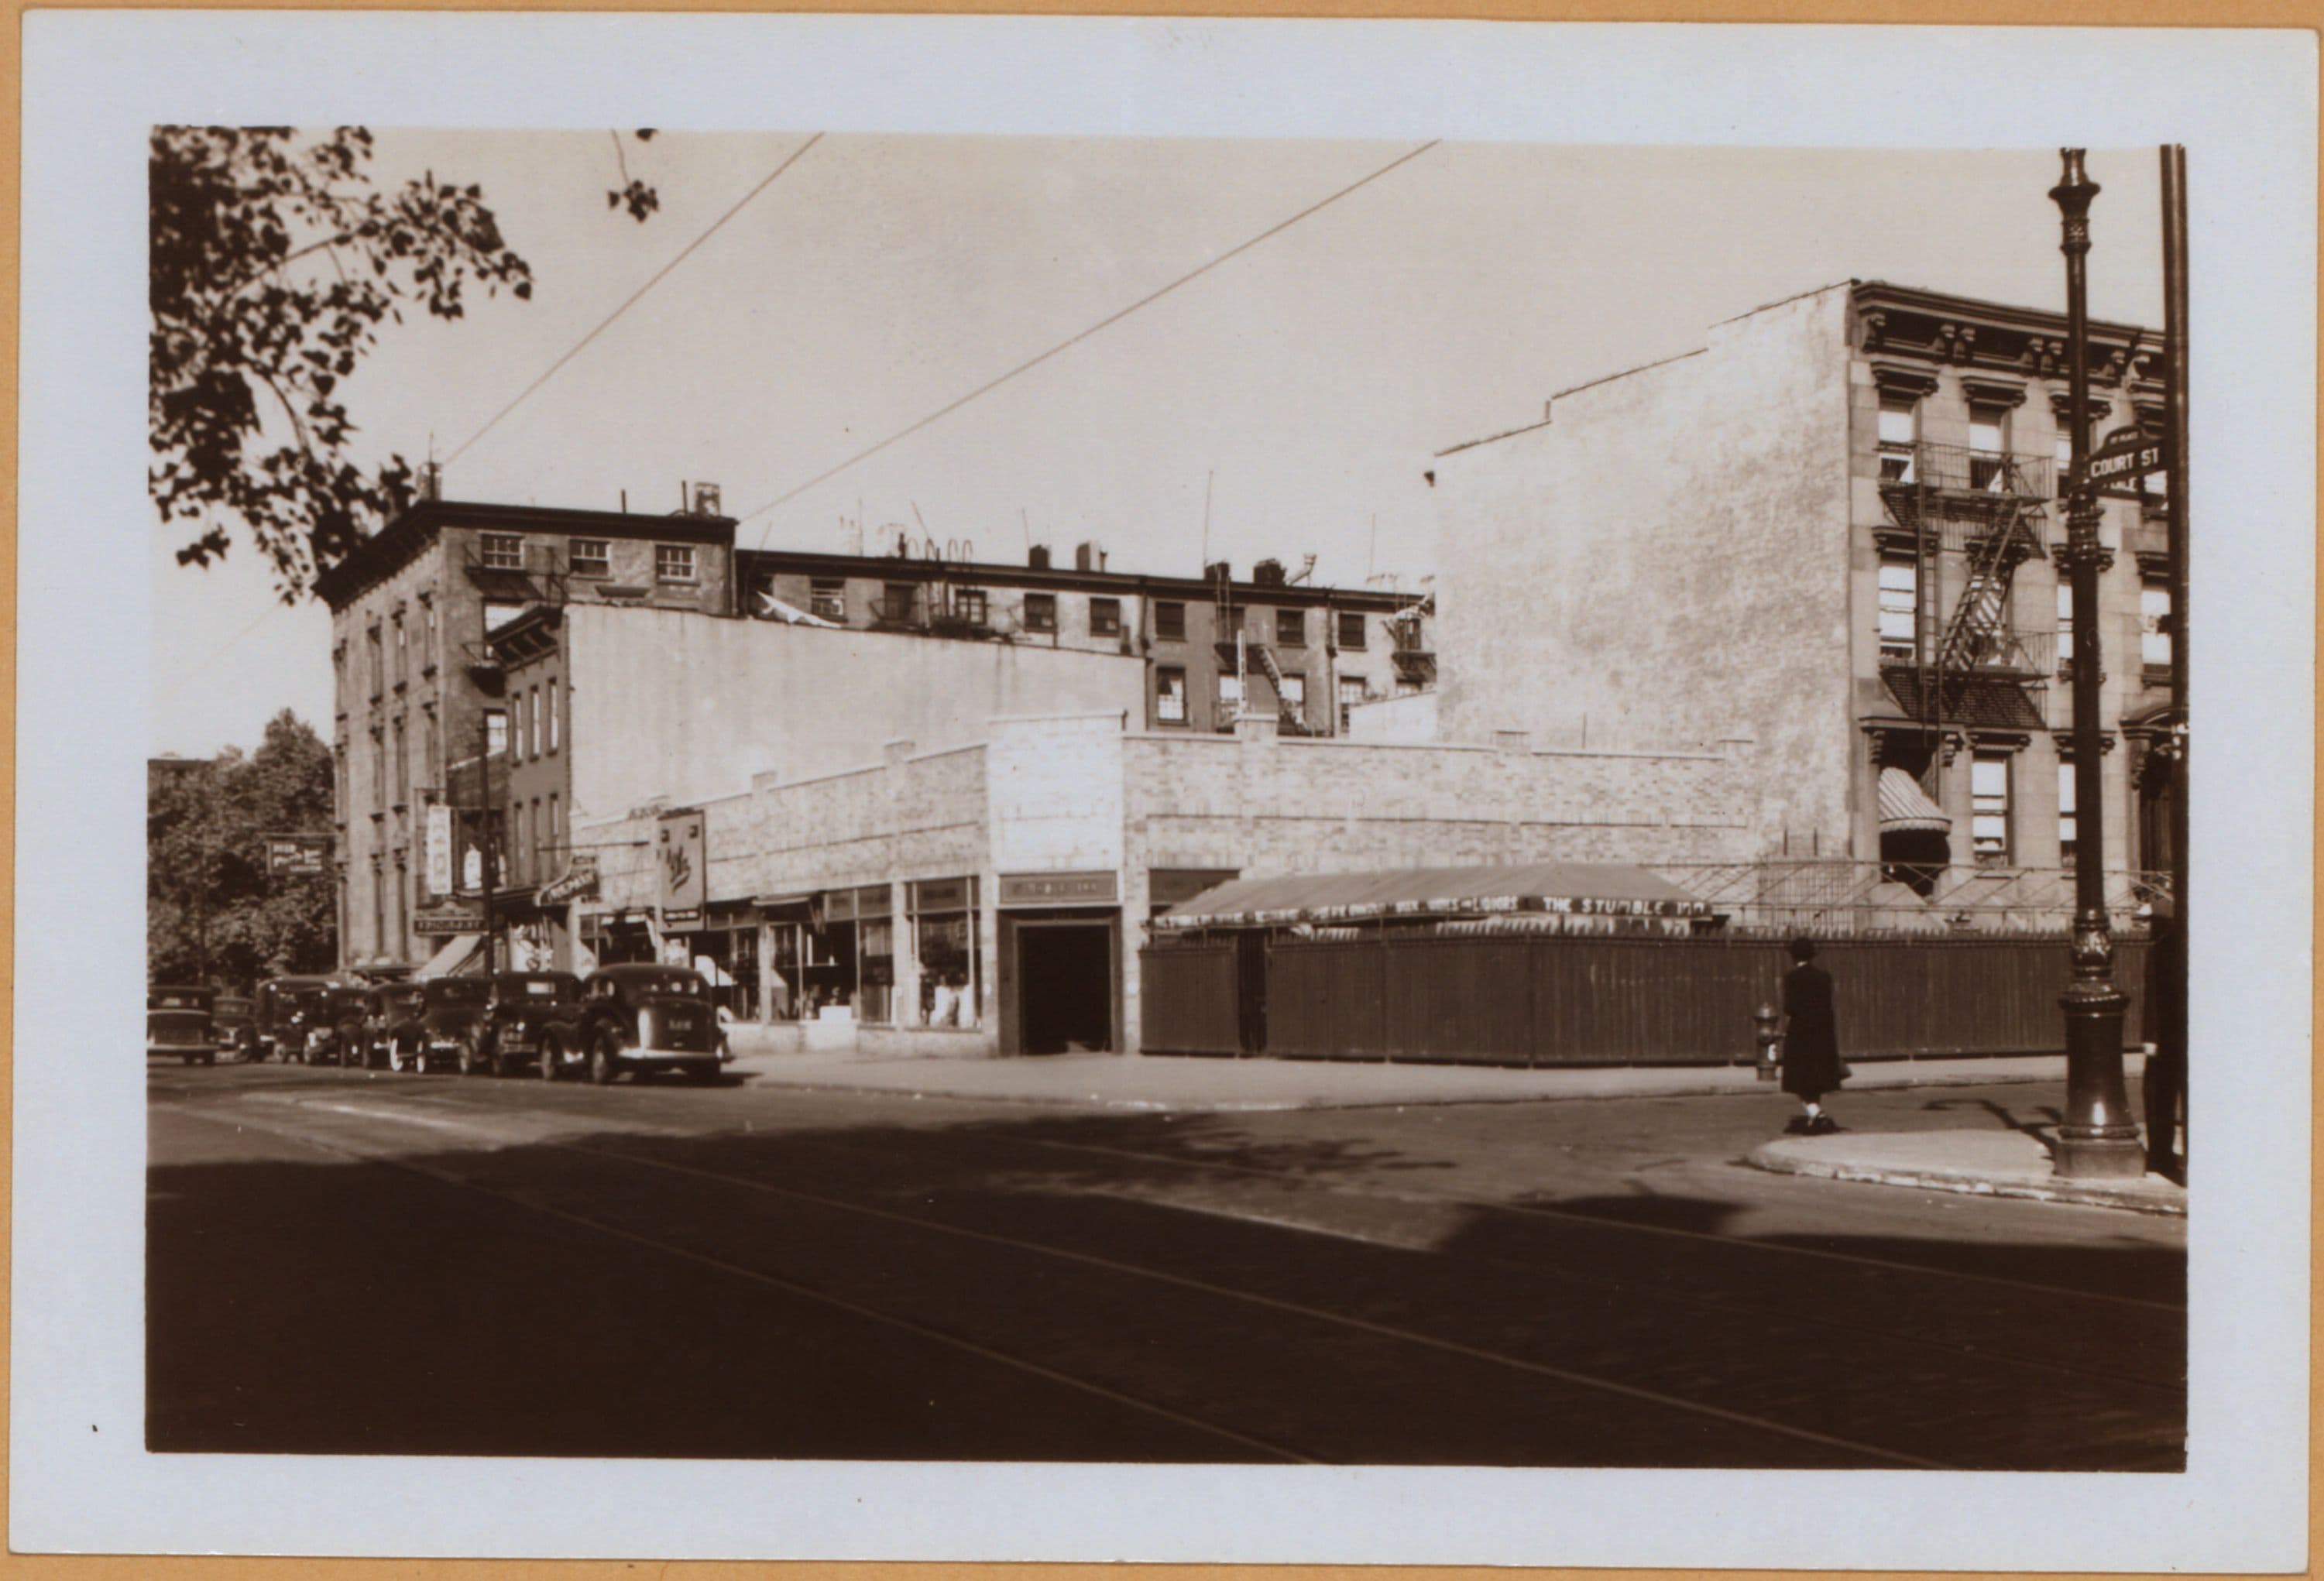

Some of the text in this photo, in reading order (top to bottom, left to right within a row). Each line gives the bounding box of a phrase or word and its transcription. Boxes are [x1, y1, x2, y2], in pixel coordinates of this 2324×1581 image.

[2090, 447, 2159, 478] COURT ST
[1543, 896, 1572, 914] THE
[1581, 897, 1666, 915] STUMBLE
